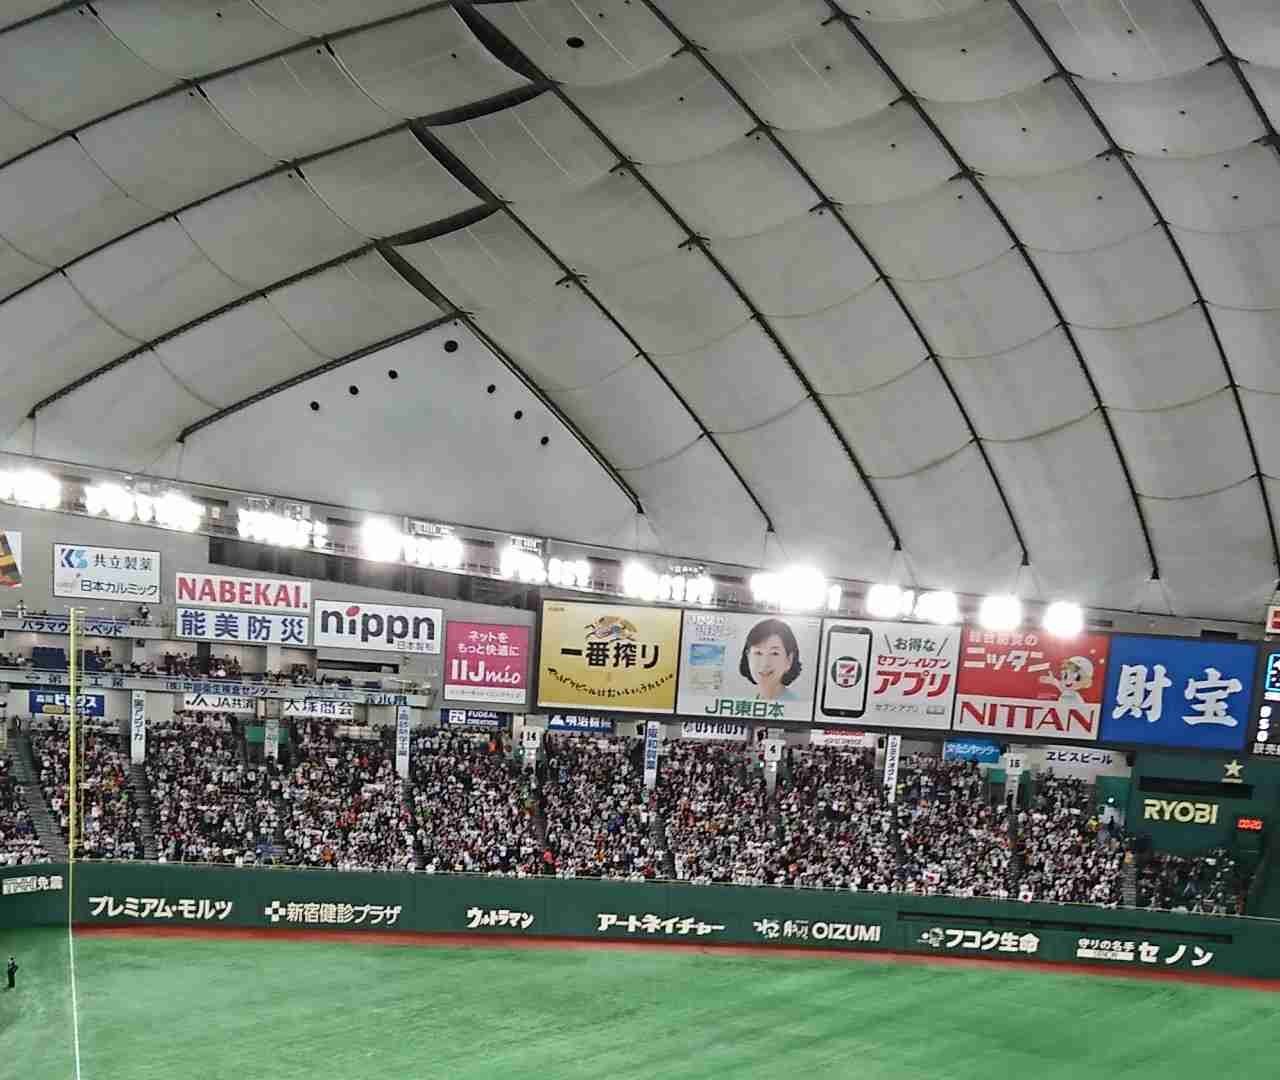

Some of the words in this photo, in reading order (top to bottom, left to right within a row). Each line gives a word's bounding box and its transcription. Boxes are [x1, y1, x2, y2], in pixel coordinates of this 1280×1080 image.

[93, 553, 153, 572] 共立製薬
[80, 578, 158, 597] 日本カルミック
[21, 620, 122, 635] パラマウベッド
[181, 609, 305, 644] 能美防災
[320, 605, 435, 644] nippn
[468, 630, 510, 643] ネットを
[457, 643, 520, 657] もっと快適に
[560, 640, 660, 670] 一番搾り
[894, 636, 937, 652] お得な
[451, 658, 522, 686] IIJmio
[963, 646, 1051, 674] ニッタン
[873, 669, 952, 698] アプリ
[1111, 662, 1242, 729] 財宝
[284, 699, 354, 716] 大塚商会
[704, 699, 785, 720] JR東日本
[959, 700, 1096, 734] NITTAN
[526, 730, 538, 742] 14
[1143, 798, 1220, 825] RYOBI
[88, 895, 234, 921] プレミアム・モルツ
[287, 901, 403, 926] 新宿健診プラザ
[465, 906, 535, 930] ウルトラマン
[596, 910, 726, 937] アートネイチャー
[812, 920, 882, 943] OIZUMI
[945, 927, 1041, 954] フコク生命
[1077, 937, 1137, 953] 守りの名手
[1137, 941, 1215, 968] セノン
